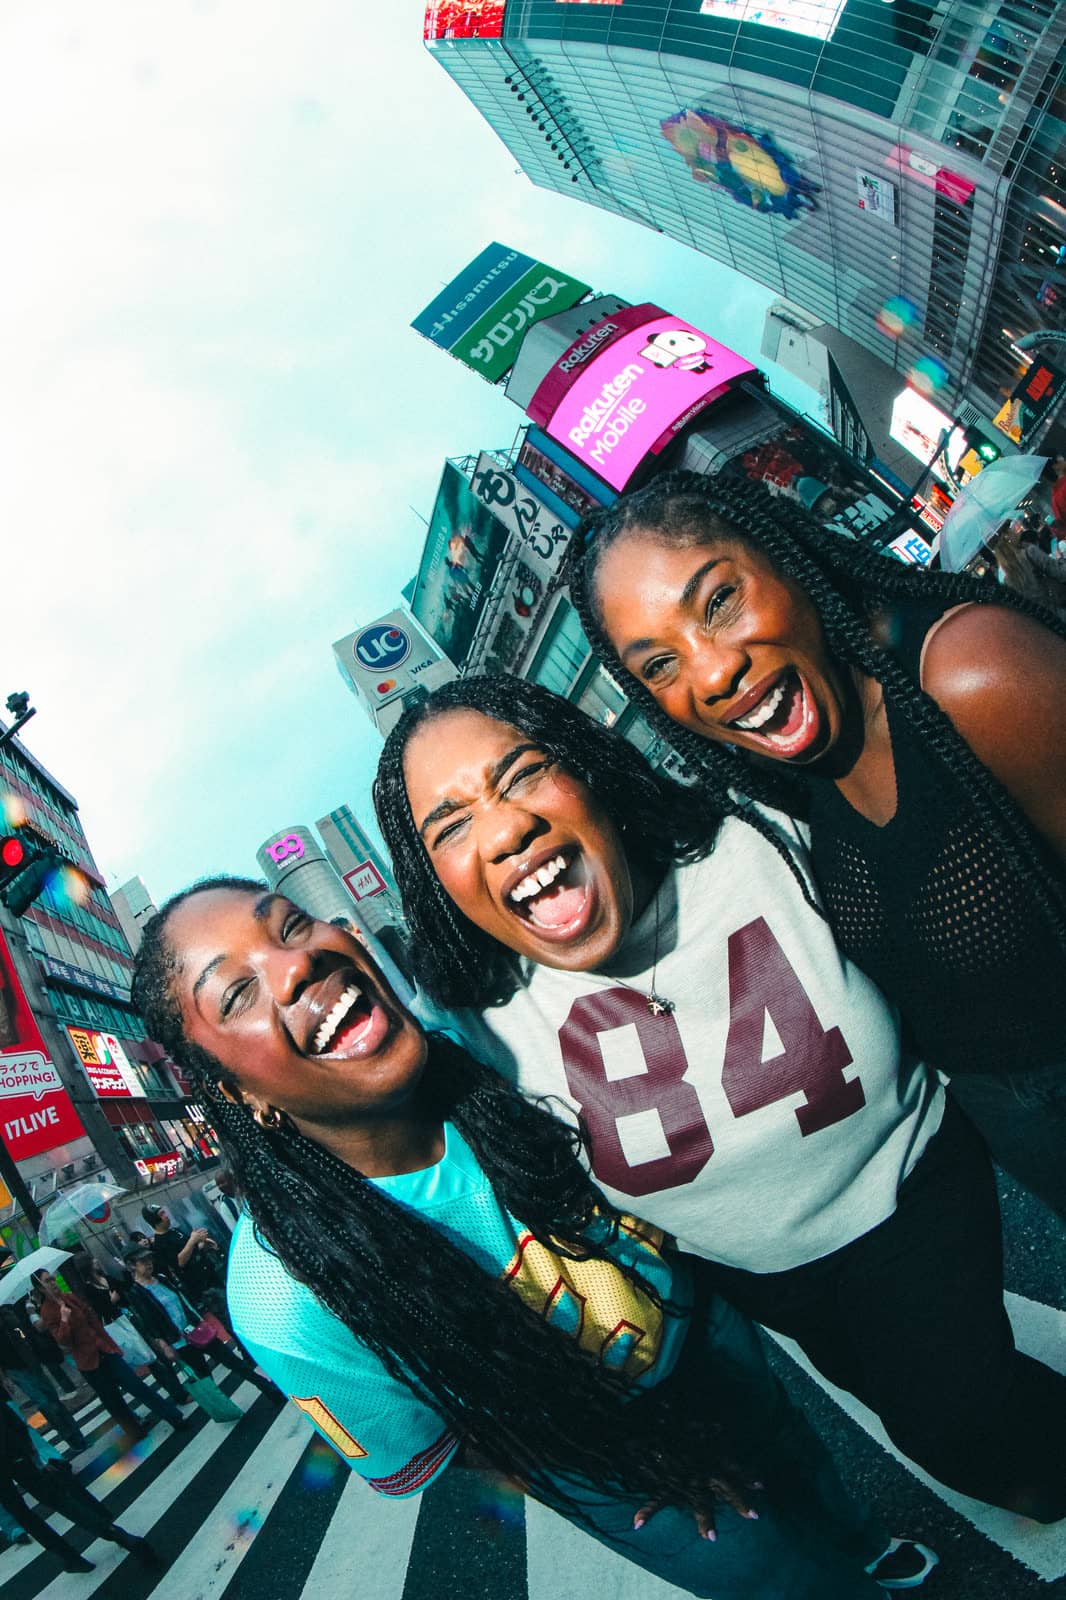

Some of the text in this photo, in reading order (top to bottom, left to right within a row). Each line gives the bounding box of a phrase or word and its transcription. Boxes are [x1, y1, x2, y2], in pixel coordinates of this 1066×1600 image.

[432, 252, 518, 336] Hisamitsu
[470, 276, 568, 363] サロンパス
[559, 322, 618, 374] Rakuten
[569, 363, 643, 448] Rakuten
[589, 397, 647, 465] Mobile
[477, 469, 569, 559] もんじゃ
[358, 630, 404, 662] UC
[558, 915, 866, 1197] 84
[4, 1106, 60, 1140] 17LIVE
